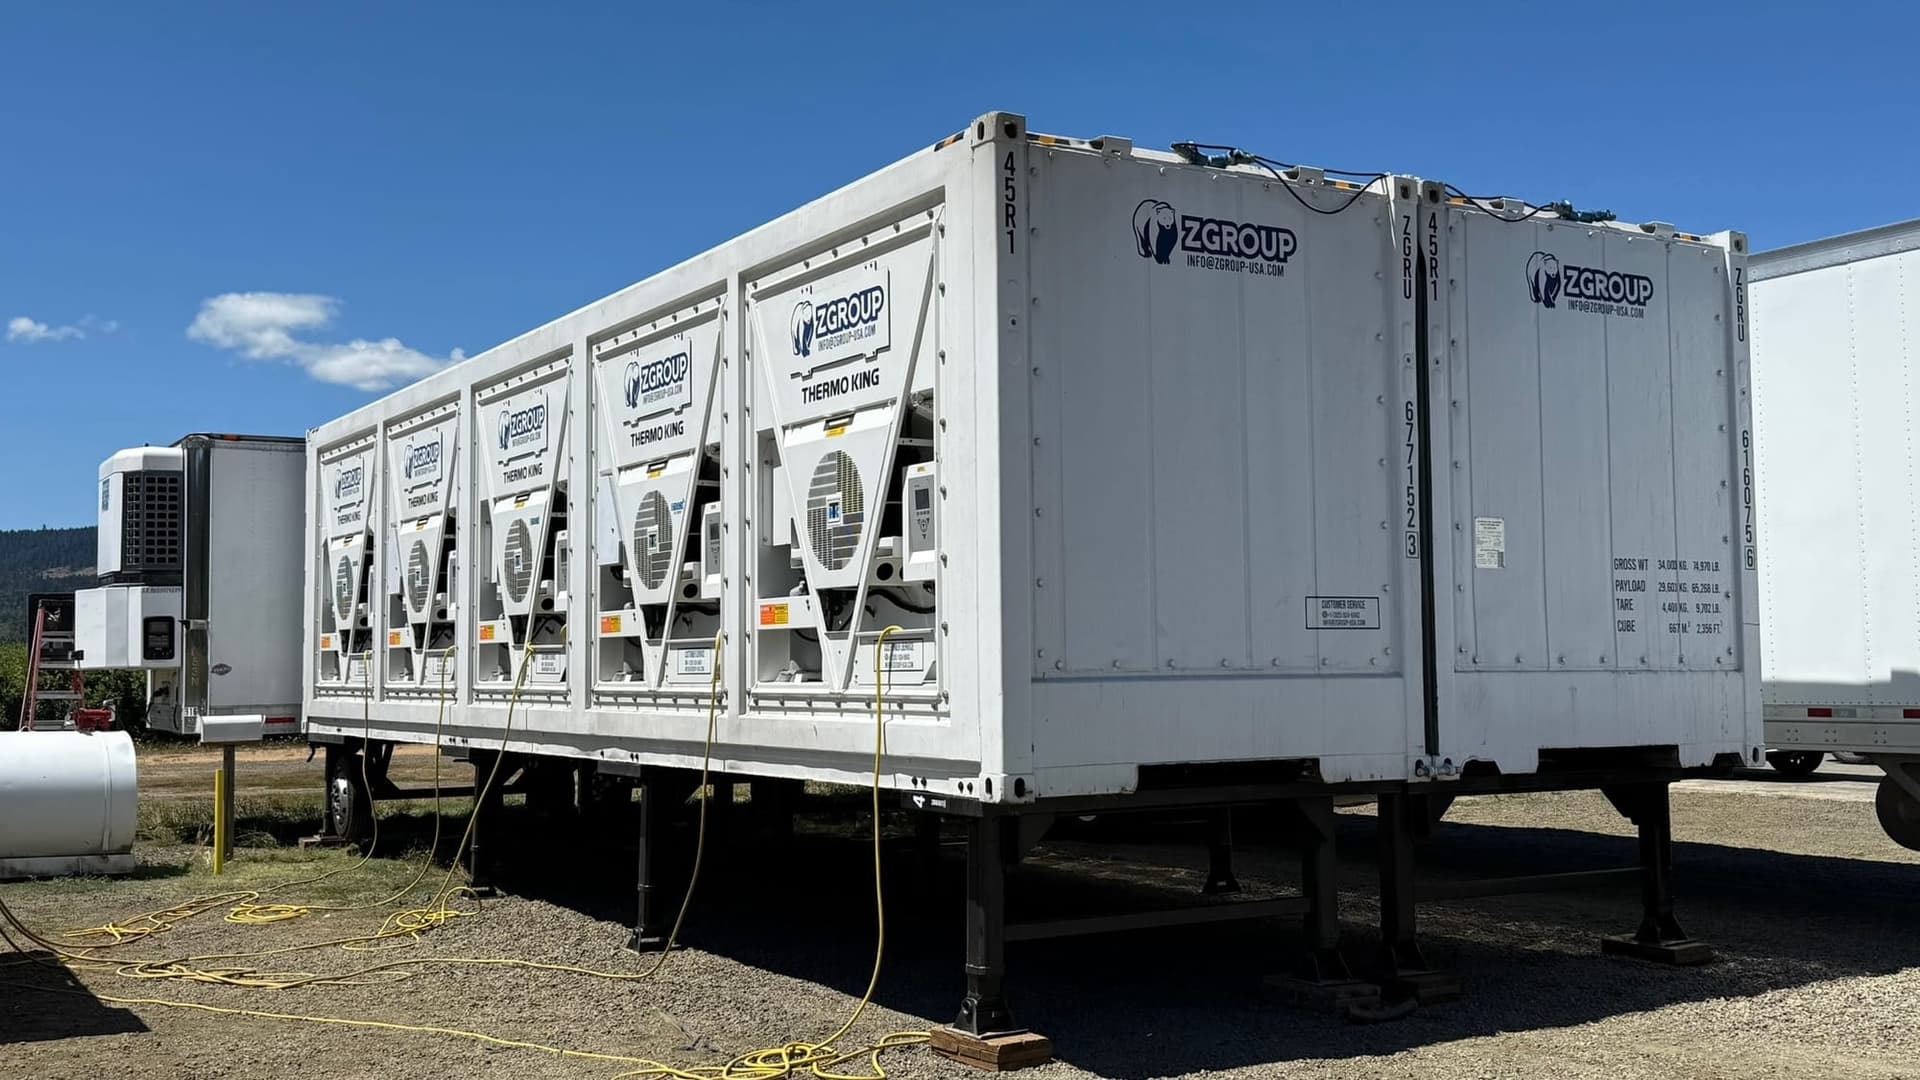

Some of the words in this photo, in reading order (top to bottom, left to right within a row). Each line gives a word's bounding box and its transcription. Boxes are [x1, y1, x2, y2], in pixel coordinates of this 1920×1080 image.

[1003, 151, 1016, 254] 45R1
[1181, 214, 1297, 263] ZGROUP
[1428, 211, 1439, 301] 45R1
[1186, 254, 1285, 278] INFO@ZGROUP-USA.COM
[1402, 214, 1412, 300] ZGRU
[1563, 264, 1654, 307] ZGROUP
[815, 285, 884, 339] ZGROUP
[1567, 299, 1645, 319] INFO@ZGROUP-USA.COM
[1735, 266, 1745, 342] ZGRU
[640, 351, 689, 394] ZGROUP
[801, 377, 849, 404] THERMO
[851, 368, 880, 393] KING
[510, 404, 546, 438] ZGROUP
[630, 426, 664, 448] THERMO
[664, 420, 685, 440] KING
[503, 465, 527, 484] THERMO
[528, 462, 543, 477] KING
[1613, 558, 1637, 570] GROSS
[1637, 559, 1648, 571] WT
[1615, 579, 1646, 592] PAYLOAD
[1616, 598, 1634, 611] TARE
[1617, 619, 1636, 632] CUBE
